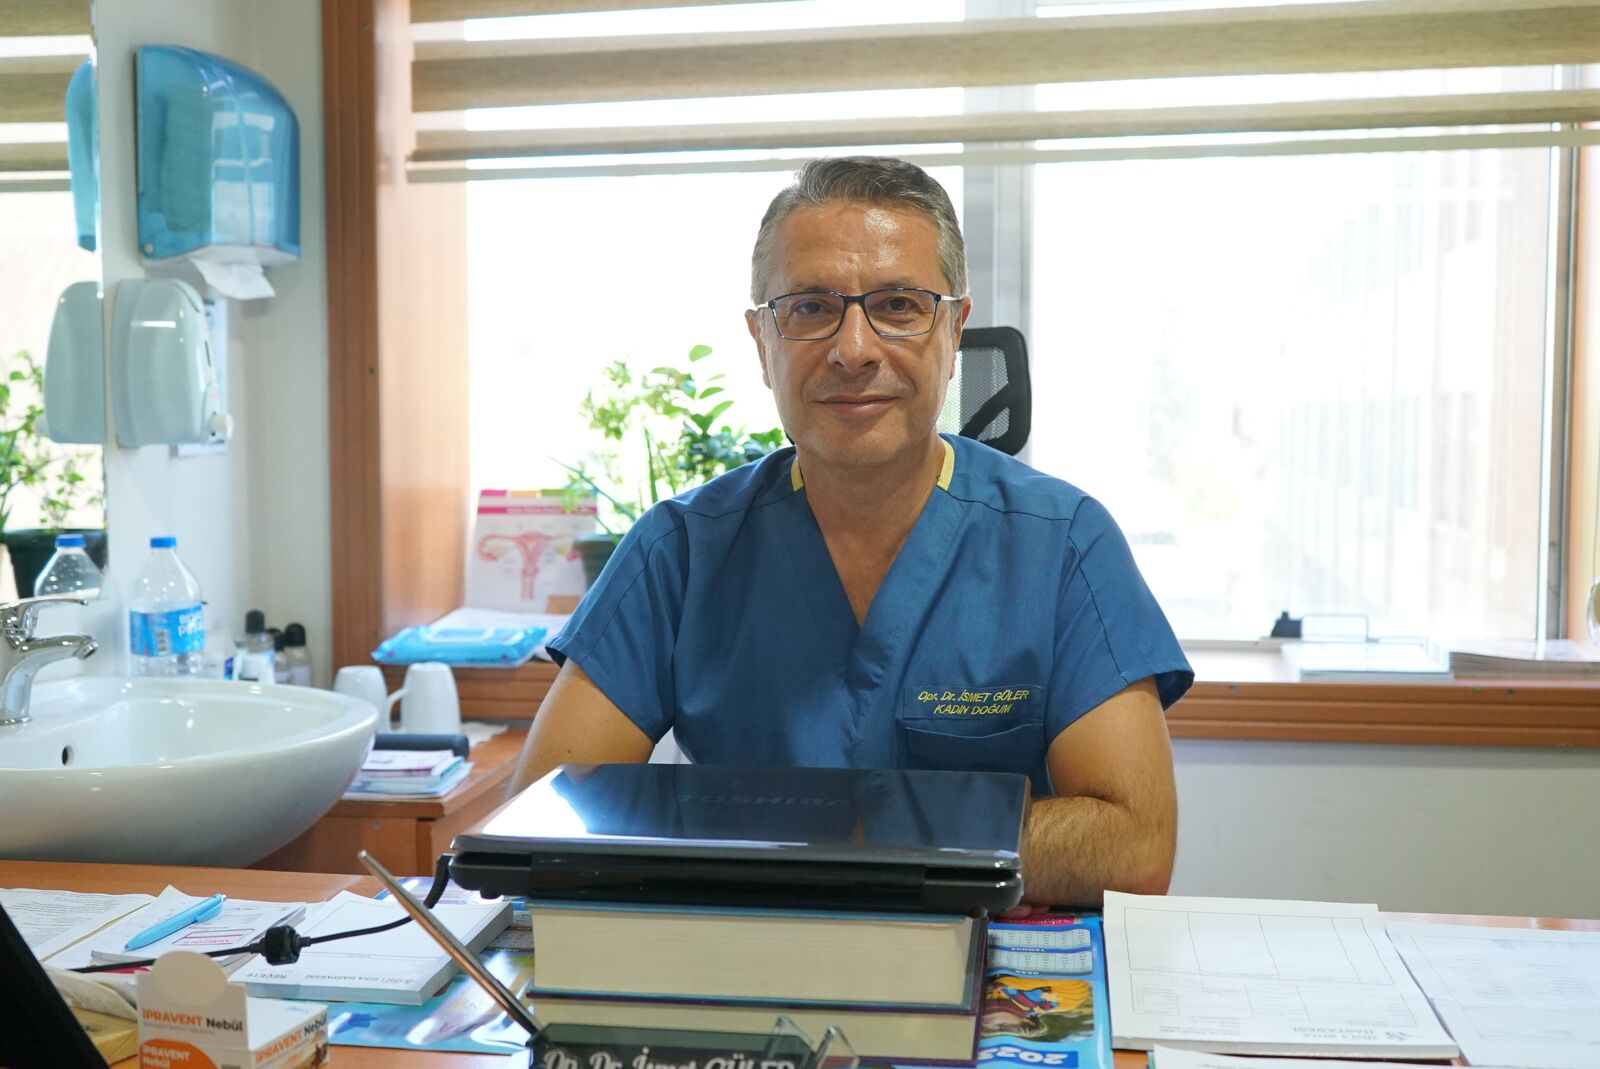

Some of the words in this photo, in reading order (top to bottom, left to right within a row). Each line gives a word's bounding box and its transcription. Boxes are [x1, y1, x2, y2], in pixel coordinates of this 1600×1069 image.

[941, 691, 956, 701] Dr.
[993, 688, 1030, 701] GÜLER
[933, 703, 970, 715] KADIN
[971, 703, 1013, 715] DOĞUM
[676, 795, 848, 807] TOSHIBA
[206, 1018, 243, 1033] Nebül
